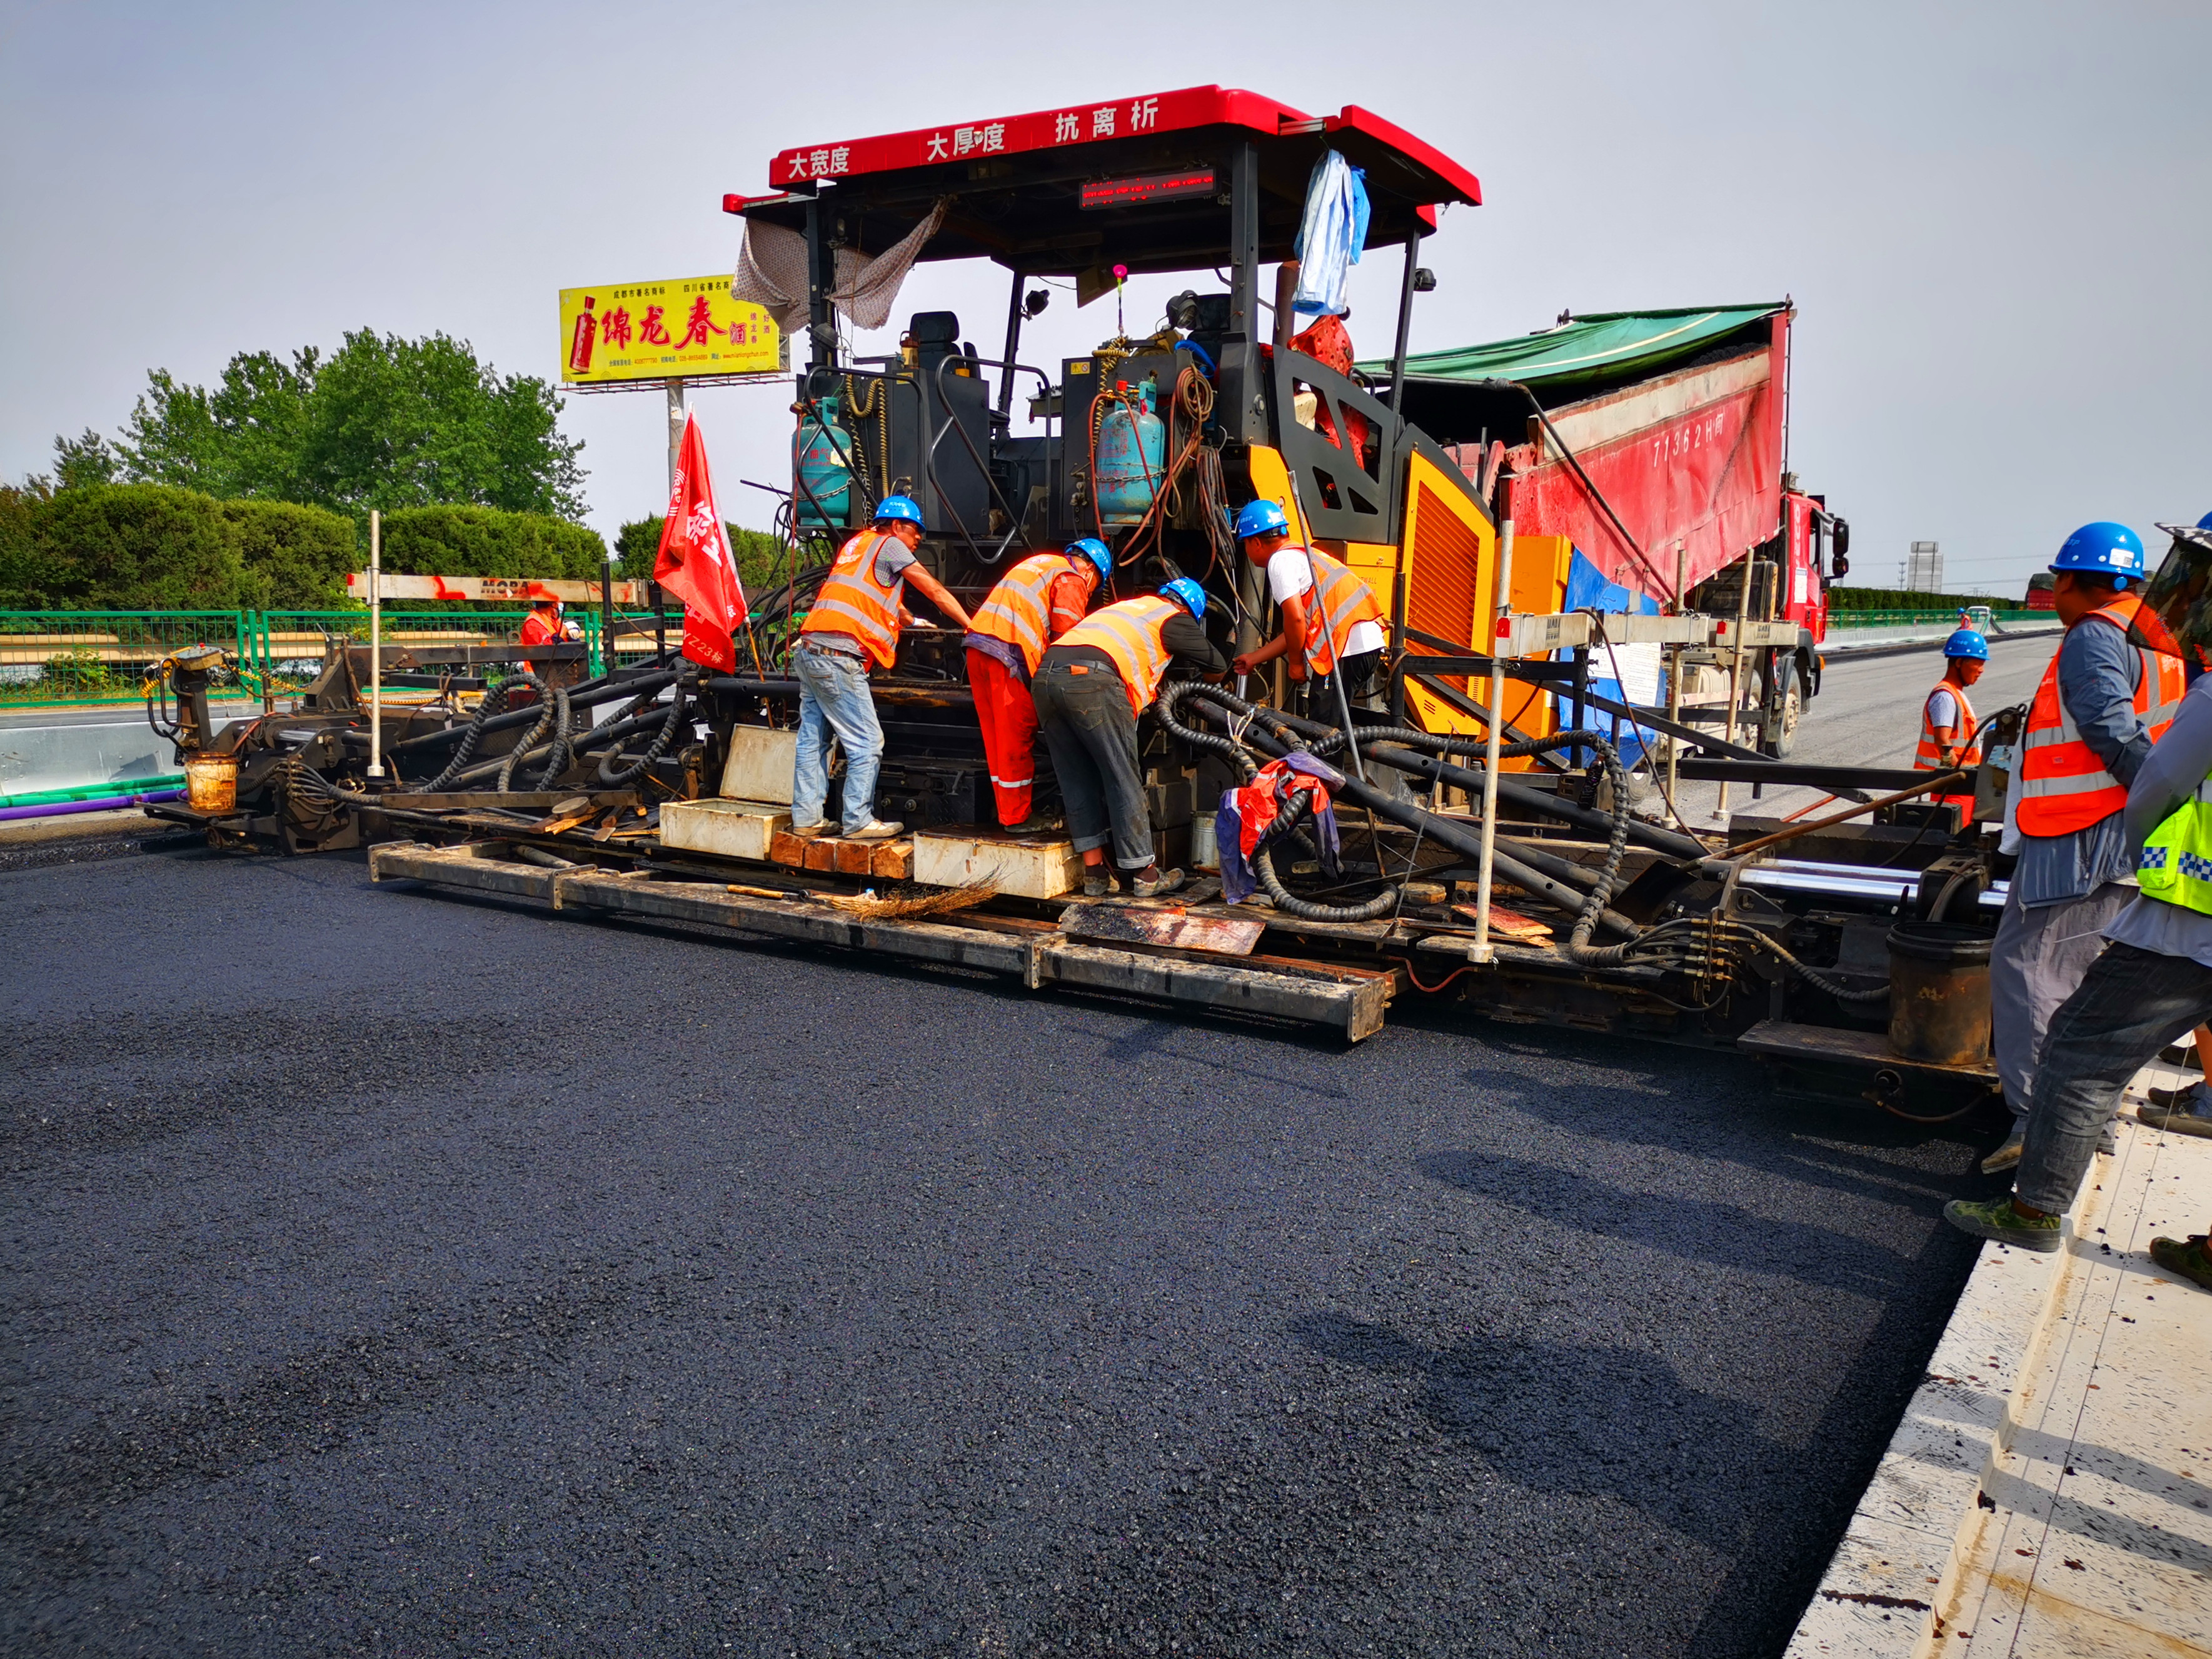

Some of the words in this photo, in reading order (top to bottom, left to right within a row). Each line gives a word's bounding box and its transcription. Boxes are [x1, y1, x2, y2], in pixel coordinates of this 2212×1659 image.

[788, 146, 850, 179] 大宽度
[927, 123, 1005, 162] 大厚度
[1055, 97, 1159, 143] 抗离析
[684, 281, 730, 293] 四川省著名商
[481, 580, 530, 595] MOBA
